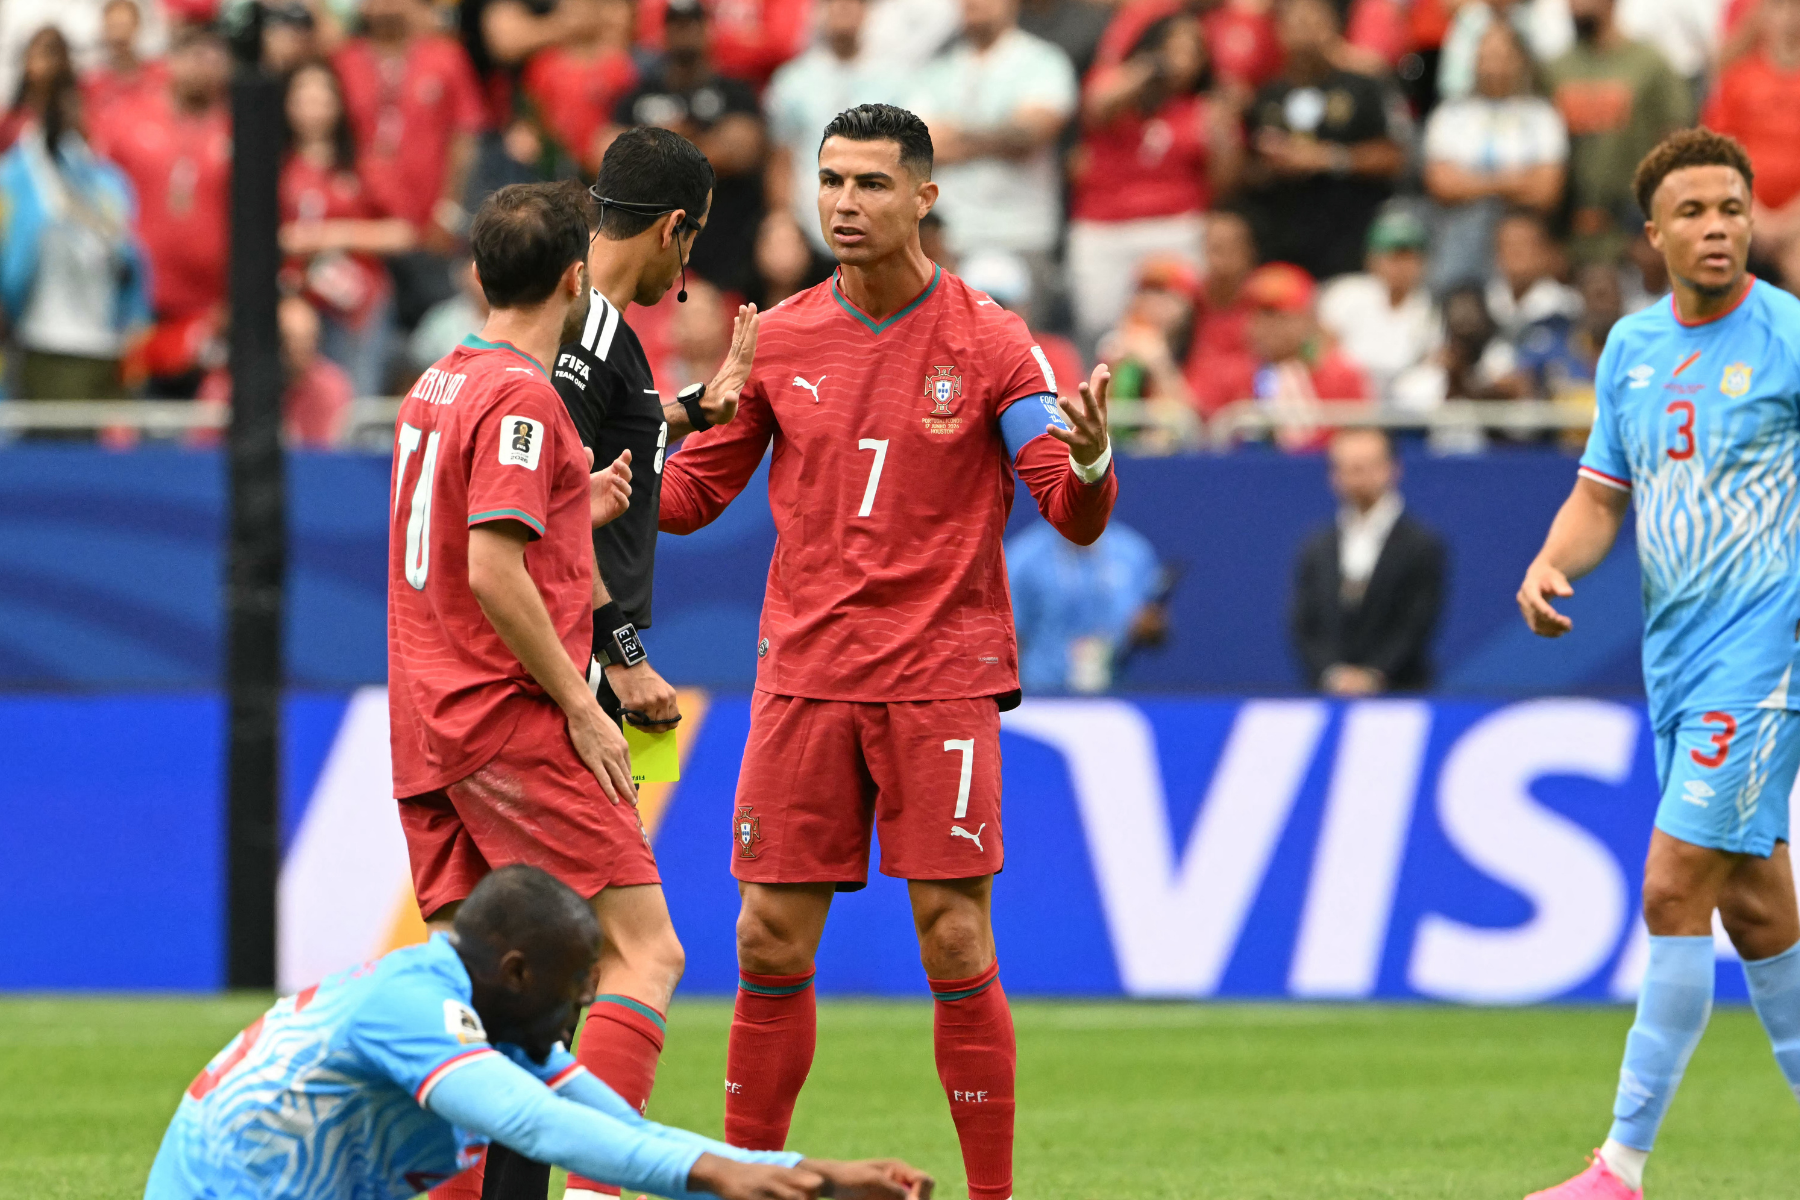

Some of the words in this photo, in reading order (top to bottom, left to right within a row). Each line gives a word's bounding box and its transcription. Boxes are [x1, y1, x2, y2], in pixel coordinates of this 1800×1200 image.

[555, 370, 575, 382] TEAM
[574, 377, 587, 391] ONE
[558, 353, 590, 381] FIFA
[1666, 399, 1696, 461] 3
[857, 437, 890, 517] 7
[1690, 710, 1738, 770] 3
[943, 738, 975, 819] 7
[954, 1090, 988, 1103] F.P.F.
